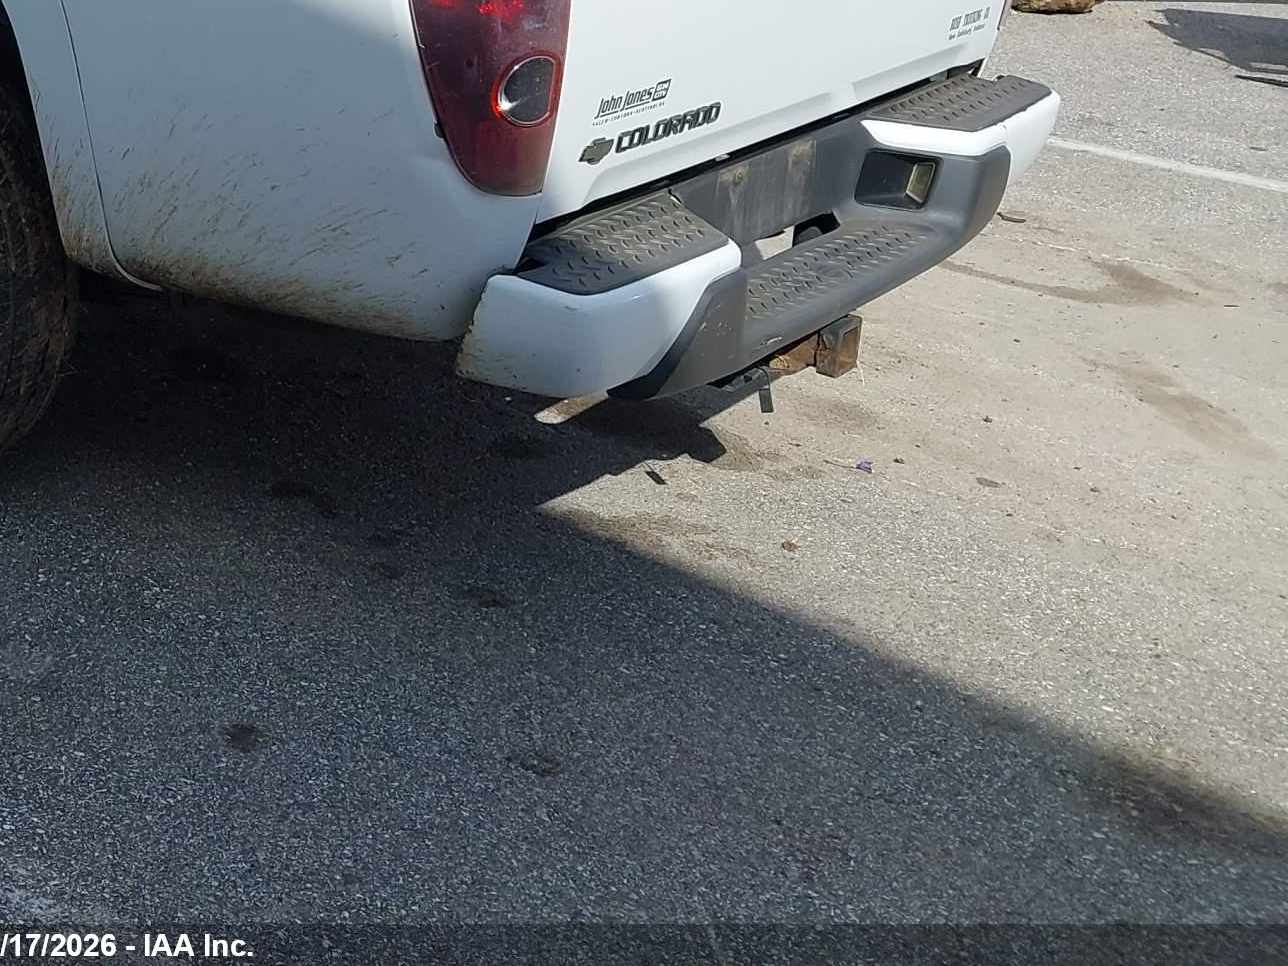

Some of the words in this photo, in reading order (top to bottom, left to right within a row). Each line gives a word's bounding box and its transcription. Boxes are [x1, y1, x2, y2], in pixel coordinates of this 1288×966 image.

[594, 95, 623, 120] John
[619, 86, 655, 112] Jones
[615, 102, 721, 154] COLORADO
